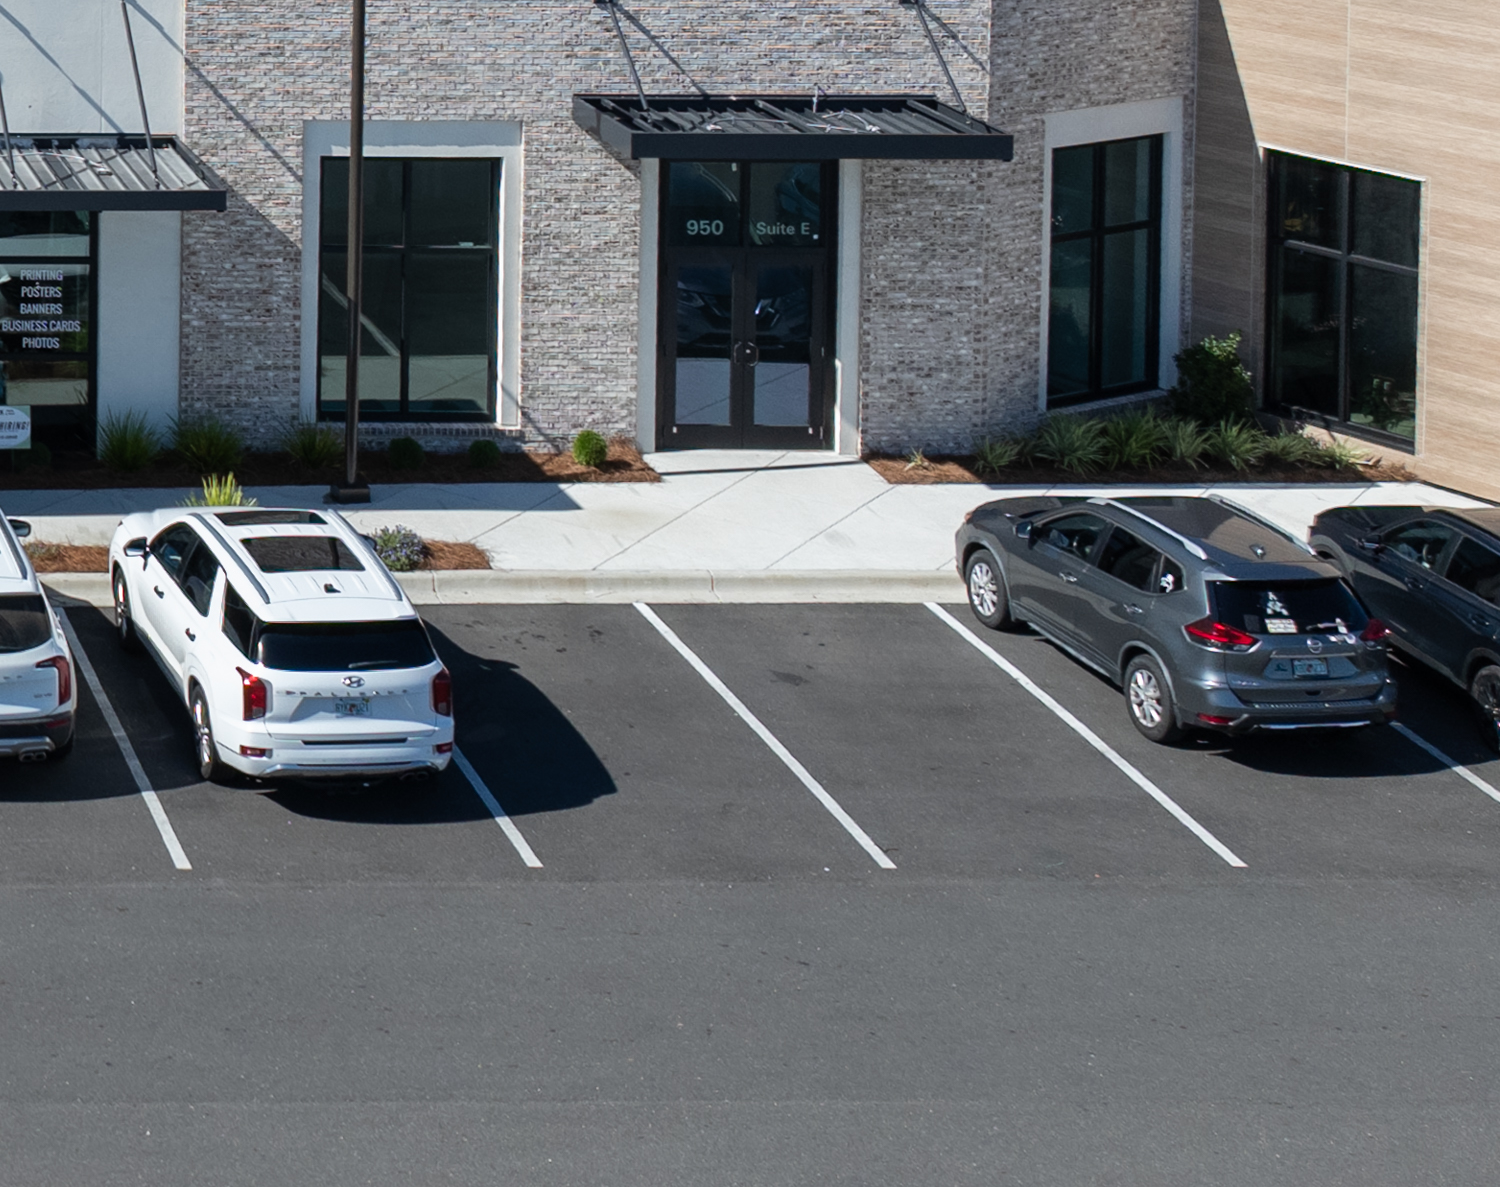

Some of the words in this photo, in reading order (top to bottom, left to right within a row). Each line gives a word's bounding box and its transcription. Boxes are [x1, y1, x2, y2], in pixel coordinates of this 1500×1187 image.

[686, 220, 724, 235] 950
[756, 221, 795, 235] Suite
[801, 222, 810, 235] E
[20, 270, 63, 281] PRINTING
[21, 286, 62, 298] POSTERS
[20, 303, 62, 314] BANNERS
[2, 320, 48, 332] BUSINESS
[50, 320, 81, 332] CARDS
[22, 337, 60, 348] PHOTOS
